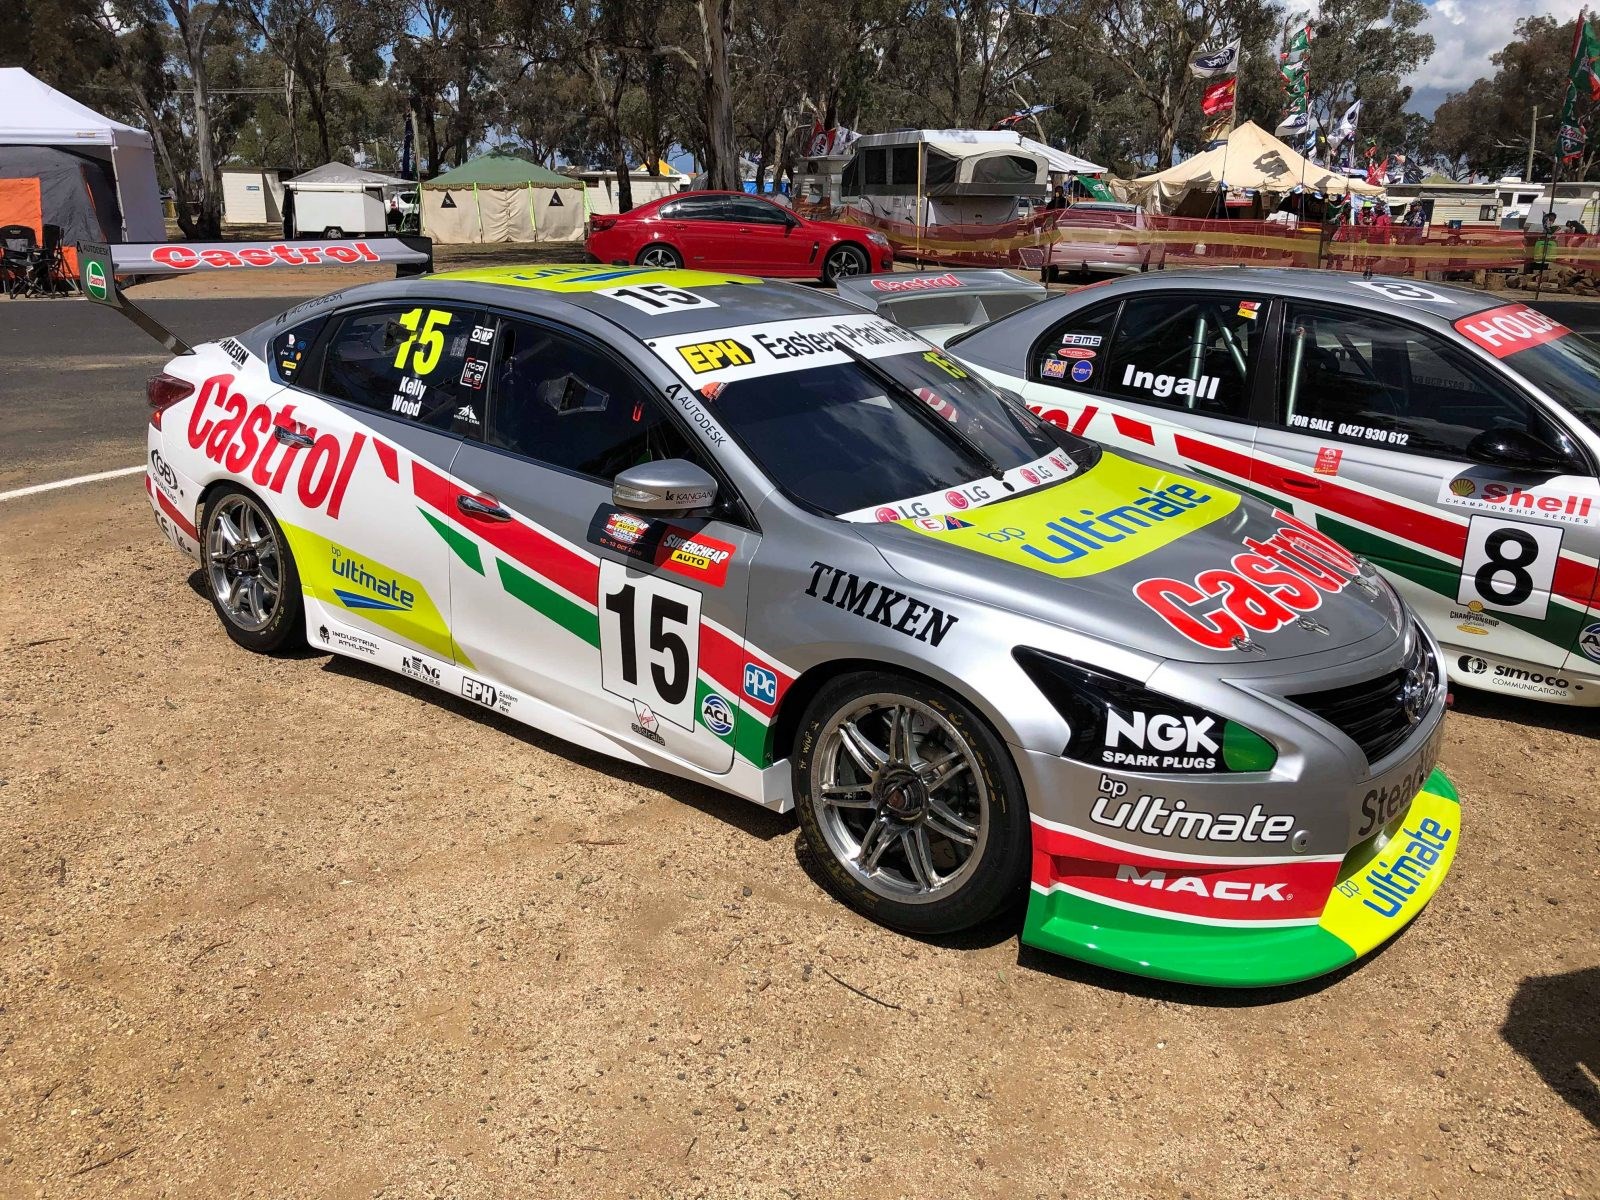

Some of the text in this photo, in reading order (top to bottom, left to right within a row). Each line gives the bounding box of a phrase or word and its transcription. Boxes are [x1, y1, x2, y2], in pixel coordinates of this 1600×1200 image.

[150, 242, 380, 269] Castrol
[612, 285, 702, 308] 15
[871, 274, 967, 292] Castrol
[752, 330, 841, 359] Eastern
[832, 322, 893, 348] Plant
[1073, 336, 1100, 345] ams
[1464, 308, 1561, 347] HOLDE
[393, 308, 452, 375] 15
[679, 341, 751, 373] EPH
[399, 376, 427, 400] Kelly
[1122, 364, 1221, 400] Ingall
[391, 394, 422, 417] Wood
[677, 395, 727, 448] AUTODESK
[1289, 414, 1409, 446] FOR SALE 0427 930 612
[187, 373, 367, 519] Castrol
[156, 456, 172, 485] GB
[1032, 465, 1053, 480] LG
[677, 490, 714, 500] KANGAN
[963, 485, 990, 503] LG
[898, 502, 930, 519] LG
[1020, 484, 1212, 564] ultimate
[1445, 497, 1590, 525] CHAMPIONSHIP SERIES
[978, 525, 1026, 544] bp
[331, 544, 342, 557] bp
[663, 533, 729, 564] SUPERCHEAP
[675, 552, 705, 567] AUTO
[1132, 508, 1362, 650] Castrol
[1474, 527, 1539, 607] 8
[332, 558, 415, 609] ultimate
[805, 560, 960, 648] TIMKEN
[1450, 611, 1500, 627] CHAMPIONSHIP
[332, 630, 380, 650] INDUSTRIAL
[338, 639, 376, 656] ATHLETE
[605, 583, 690, 705] 15
[401, 667, 441, 686] SPRINGS
[745, 668, 776, 698] PPG
[1492, 677, 1568, 697] COMMUNICATIONS
[463, 677, 494, 706] EPH
[703, 706, 733, 727] ACL
[631, 722, 666, 747] australia
[1104, 707, 1220, 755] NGK
[1102, 750, 1216, 769] SPARK PLUGS
[1098, 774, 1128, 798] bp
[1090, 795, 1296, 842] ultimate
[1362, 817, 1453, 918] ultimate
[1115, 864, 1289, 902] MACK
[1336, 879, 1362, 900] bp
